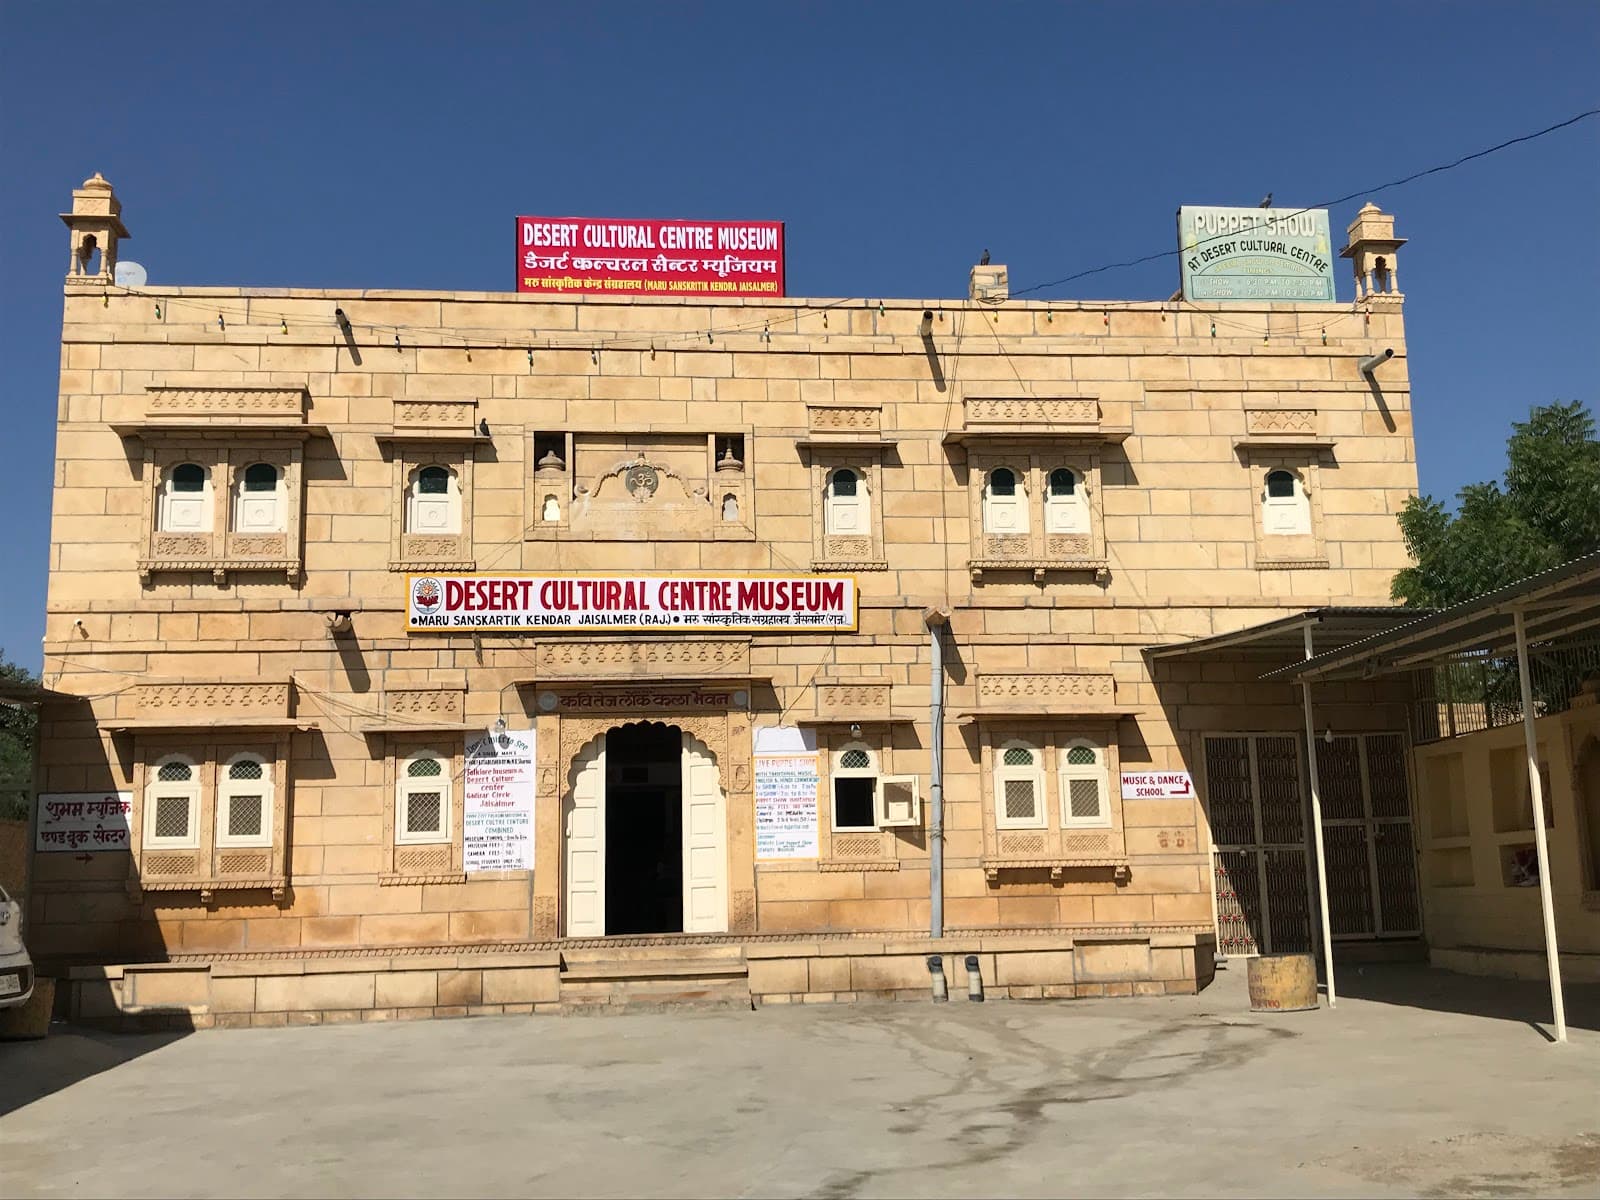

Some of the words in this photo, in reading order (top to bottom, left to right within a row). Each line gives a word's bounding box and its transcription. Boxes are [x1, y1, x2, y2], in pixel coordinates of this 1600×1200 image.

[1194, 212, 1260, 236] PUPPET
[1264, 214, 1317, 238] SHOW
[523, 223, 578, 247] DESERT
[583, 224, 656, 249] CULTURAL
[659, 226, 714, 250] CENTRE
[718, 227, 778, 251] MUSEUM
[1187, 256, 1201, 272] AT
[1200, 241, 1237, 261] DESERT
[1240, 240, 1288, 255] CULTURAL
[1290, 247, 1329, 273] CENTRE
[571, 257, 649, 272] कल्चरल
[644, 278, 667, 291] (MARU
[668, 280, 709, 292] SANSKRITIK
[710, 281, 737, 292] KENDRA
[739, 280, 778, 293] JAISALMER)
[445, 580, 533, 611] DESERT
[540, 580, 650, 611] CULTURAL
[658, 581, 728, 611] CENTRE
[738, 581, 844, 611] MUSEUM
[419, 615, 449, 626] MARU
[453, 614, 521, 626] SANSKARTIK
[526, 614, 571, 625] KENDAR
[578, 614, 637, 625] JAISALMER
[1122, 776, 1147, 785] MUSIC
[1149, 776, 1156, 785] &
[1158, 775, 1184, 785] DANCE
[1136, 788, 1165, 797] SCHOOL
